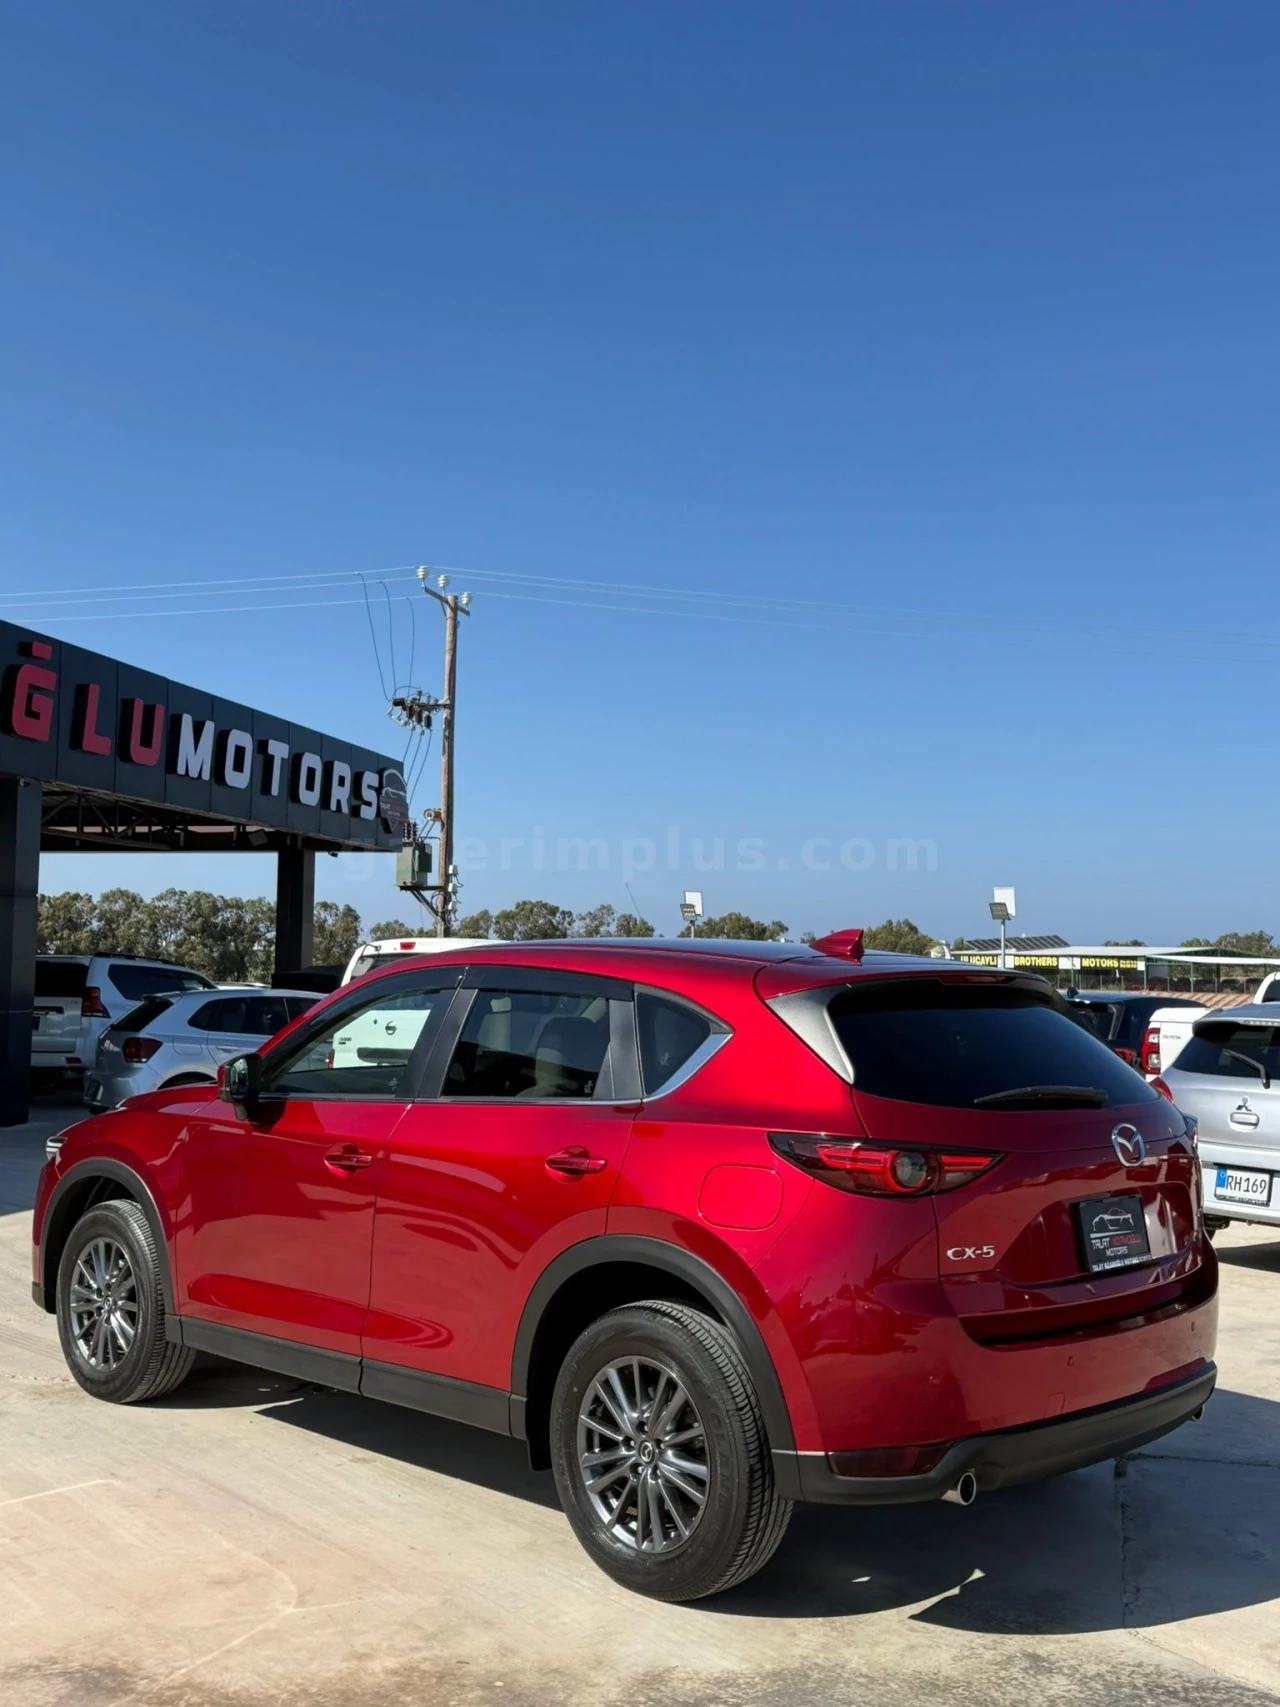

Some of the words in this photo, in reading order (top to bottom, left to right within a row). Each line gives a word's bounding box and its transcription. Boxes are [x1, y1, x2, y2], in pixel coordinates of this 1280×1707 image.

[176, 711, 380, 821] MOTORS
[1014, 956, 1058, 967] BROTHERS
[1081, 957, 1119, 968] MOTORS
[1225, 1174, 1267, 1195] RH169
[946, 1245, 995, 1260] CX-5
[1105, 1245, 1128, 1257] MOTORS
